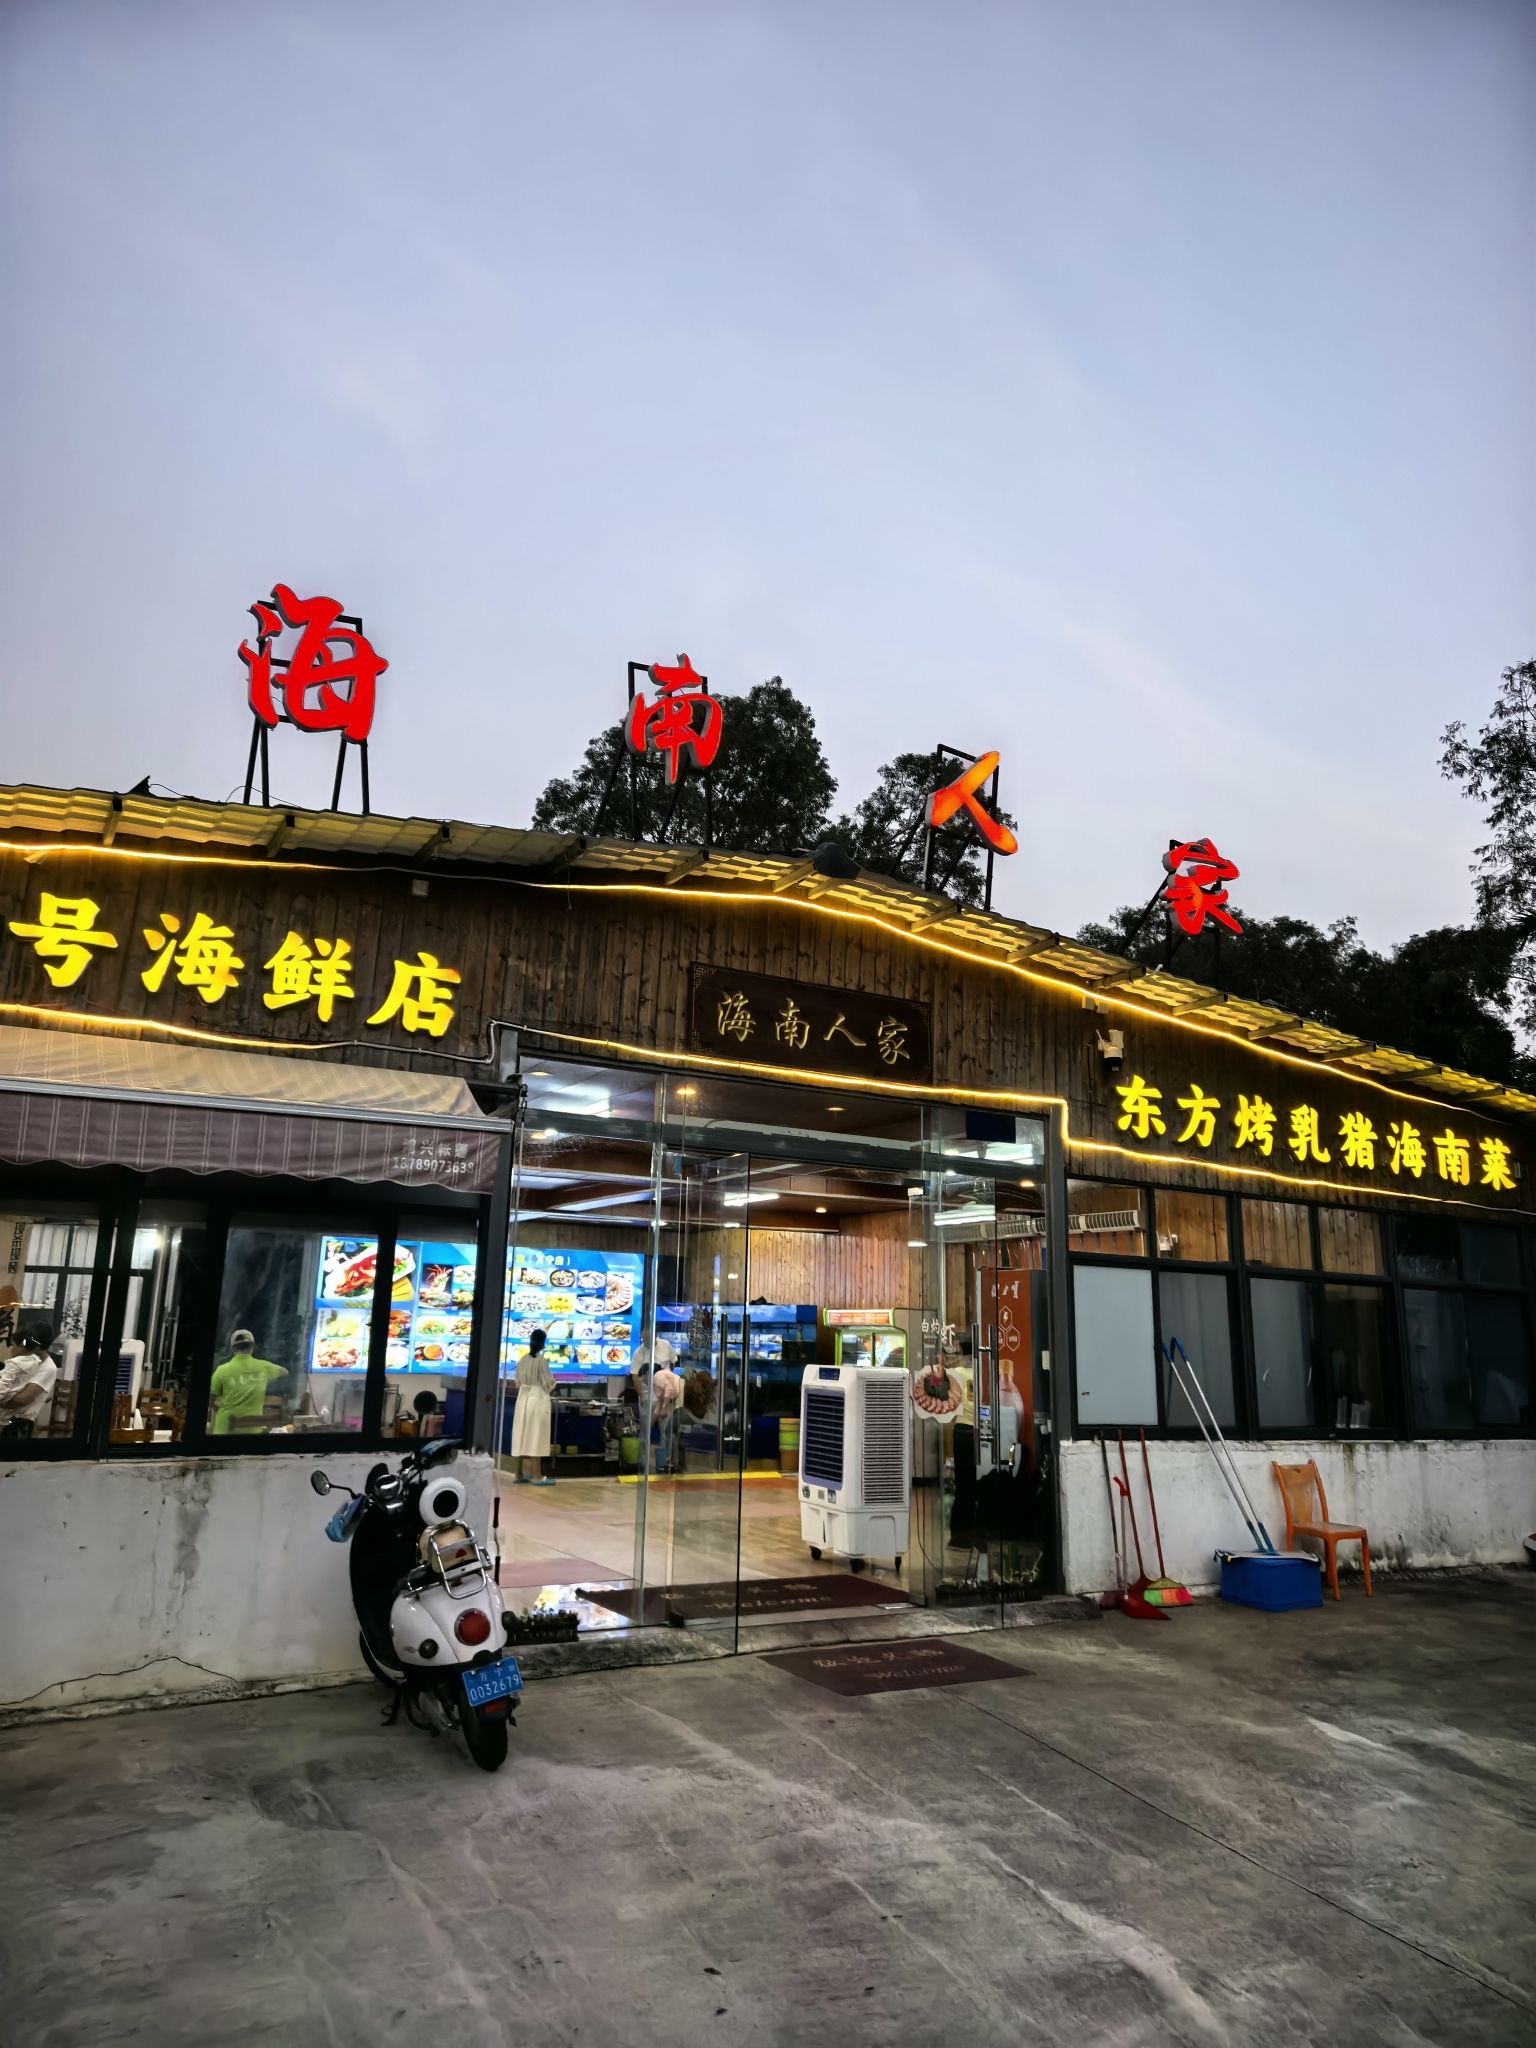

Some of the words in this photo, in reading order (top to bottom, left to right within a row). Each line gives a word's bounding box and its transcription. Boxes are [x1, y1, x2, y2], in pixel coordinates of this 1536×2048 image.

[237, 583, 1243, 936] 海南人家
[8, 890, 462, 1038] 号海鲜店
[717, 989, 911, 1065] 海南人家
[1114, 1073, 1518, 1192] 东方烤乳猪海南菜
